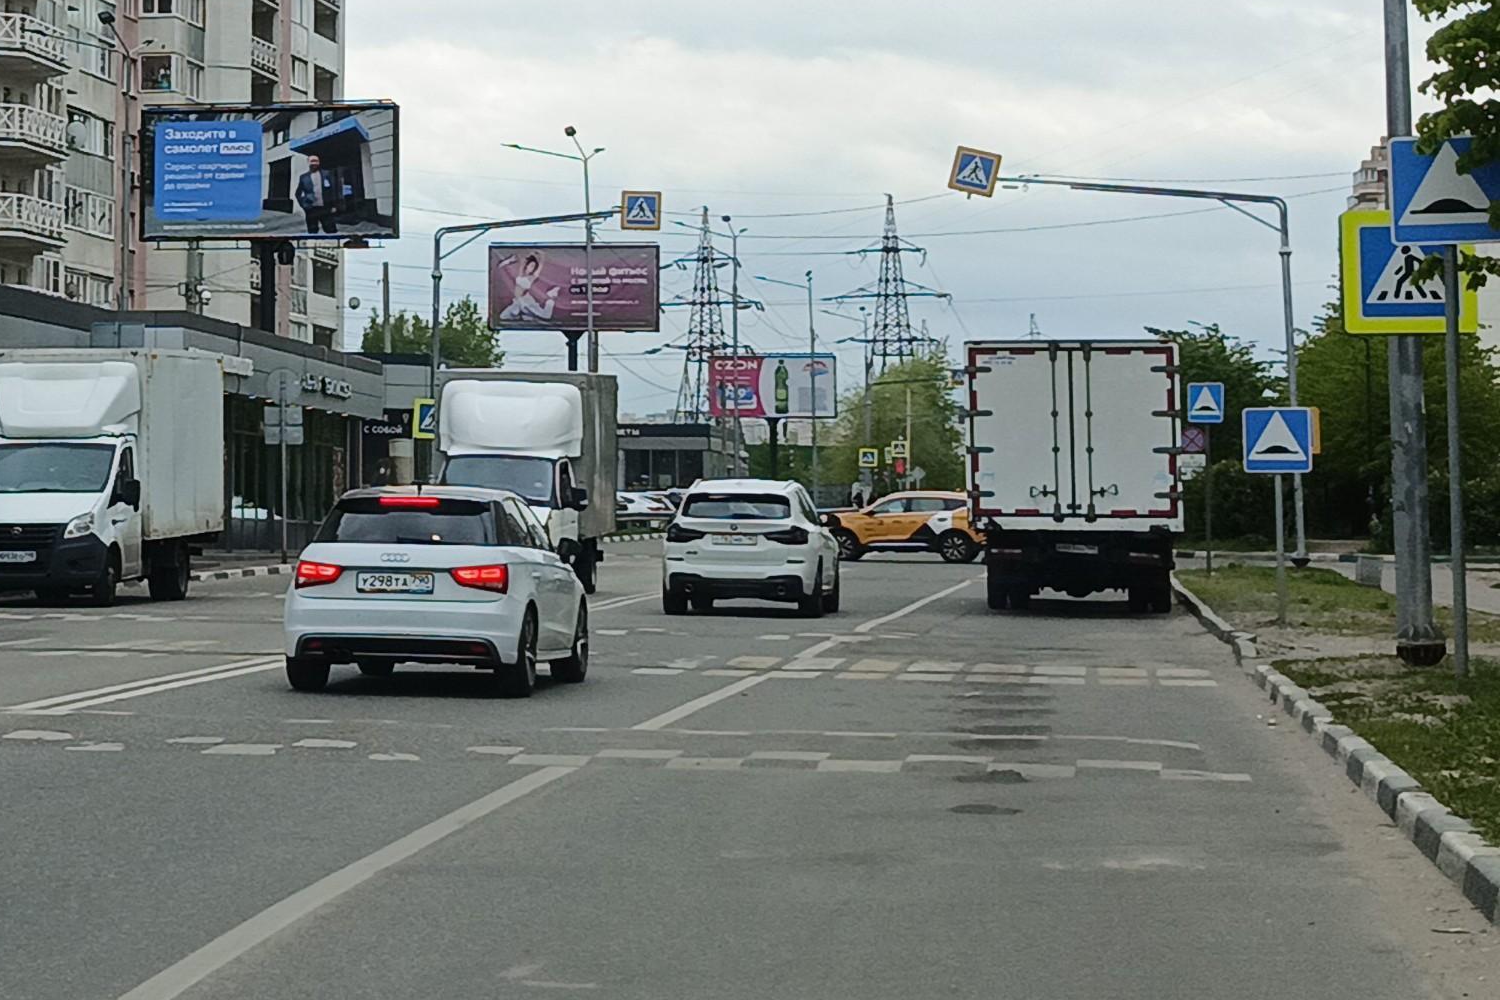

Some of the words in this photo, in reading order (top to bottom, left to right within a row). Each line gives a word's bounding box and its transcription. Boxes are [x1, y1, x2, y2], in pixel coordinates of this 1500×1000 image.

[164, 128, 227, 141] Заходите
[228, 130, 237, 139] в
[164, 144, 218, 155] самолет
[714, 360, 758, 371] OZON
